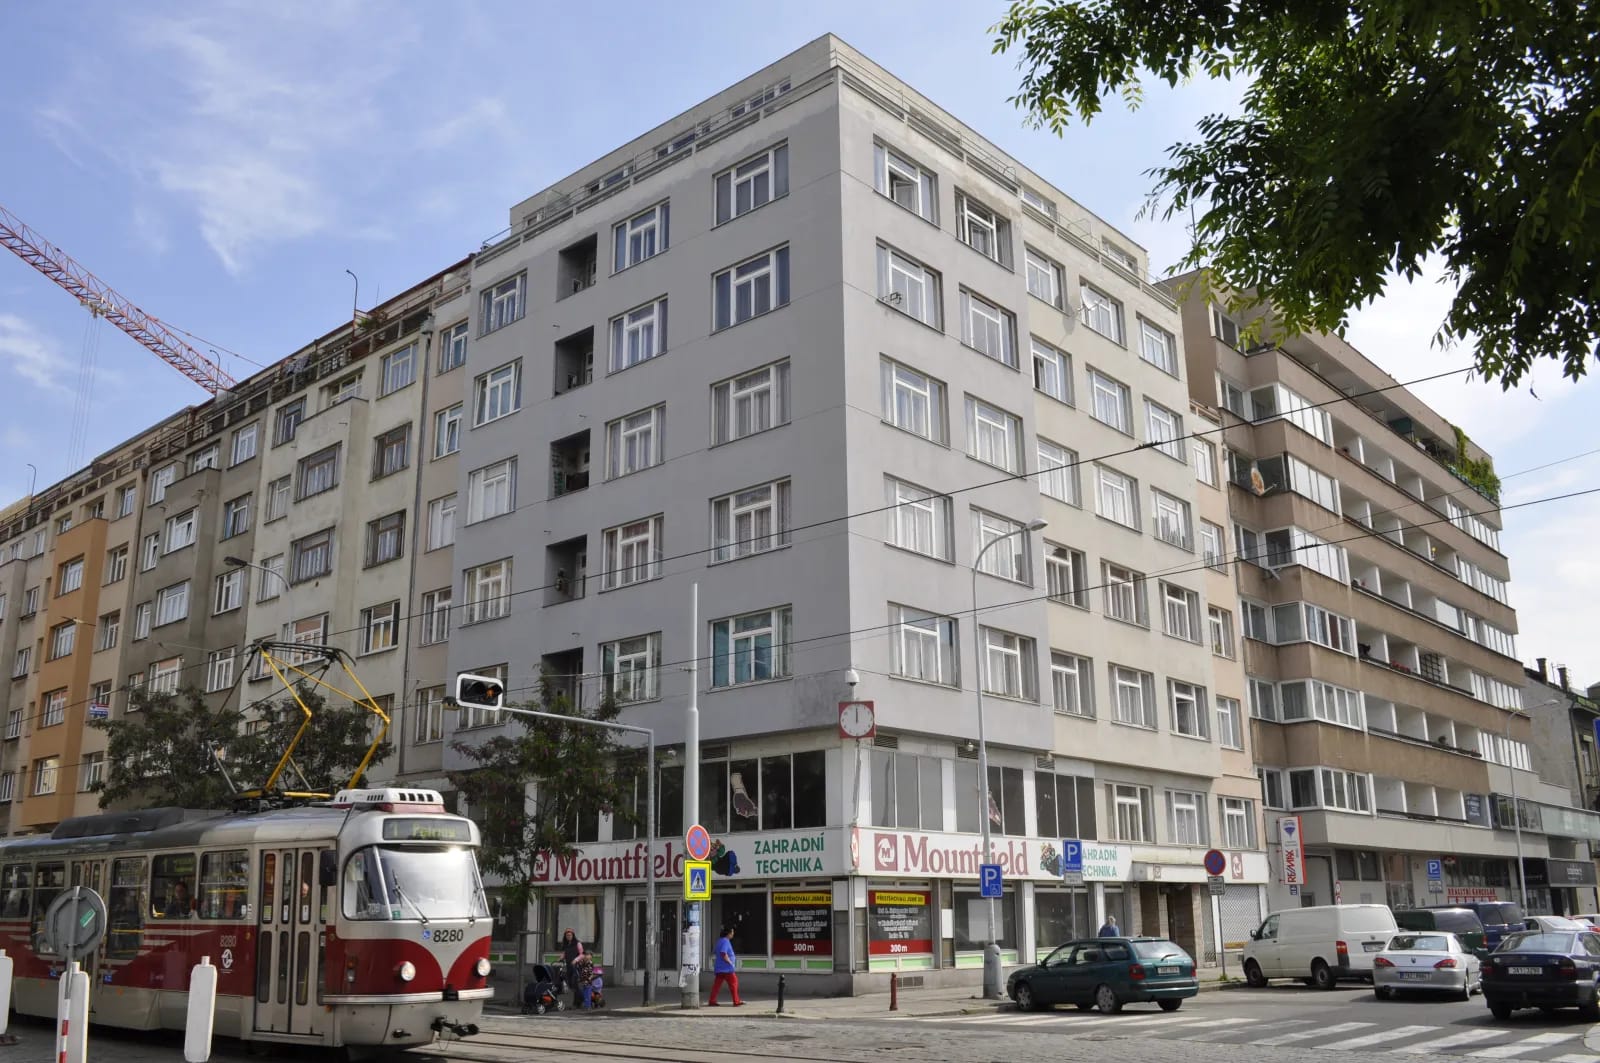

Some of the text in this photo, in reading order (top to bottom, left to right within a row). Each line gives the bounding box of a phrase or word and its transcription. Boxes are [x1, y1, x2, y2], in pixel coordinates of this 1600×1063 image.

[754, 832, 824, 855] ZAHRADNÍ
[881, 847, 891, 859] M
[903, 835, 1029, 876] Mountield
[1067, 844, 1078, 861] P
[1082, 846, 1117, 861] AHRADNÍ
[756, 857, 824, 874] TECHNIKA
[1082, 864, 1117, 877] ECHNIKA
[1429, 862, 1438, 874] P
[984, 868, 997, 887] P
[220, 935, 237, 947] 8280
[433, 929, 464, 943] 8280
[793, 943, 815, 952] 300 m
[890, 943, 908, 953] 300 m
